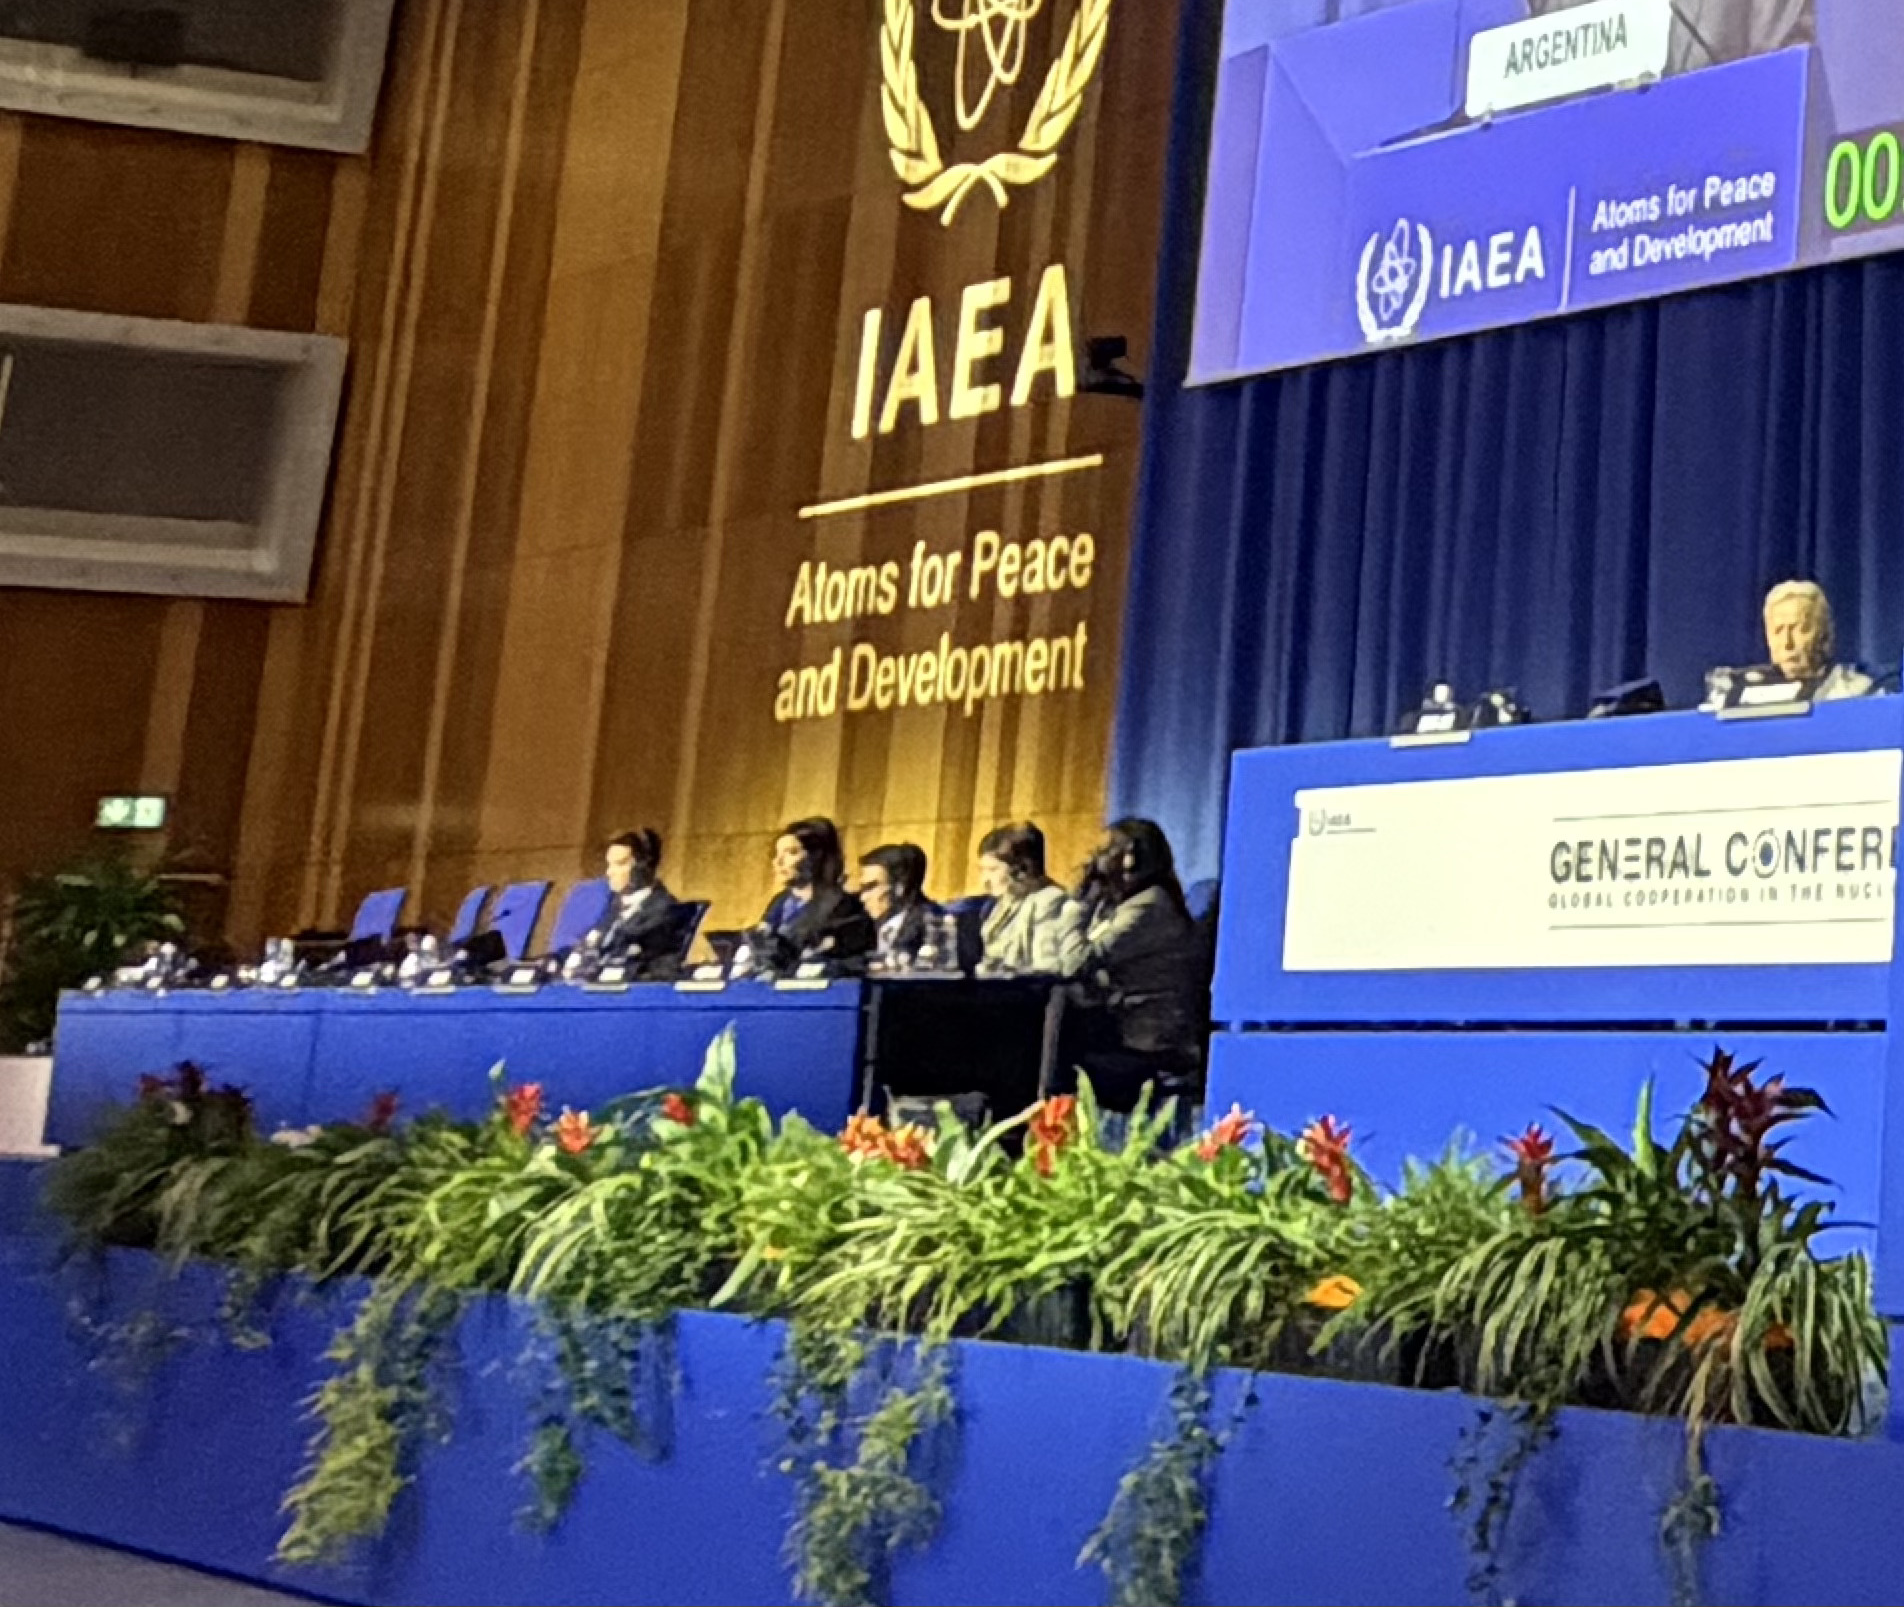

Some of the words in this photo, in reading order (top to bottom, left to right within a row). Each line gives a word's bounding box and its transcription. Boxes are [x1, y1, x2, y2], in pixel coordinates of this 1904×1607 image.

[1504, 13, 1628, 79] ARGENTINA
[1592, 197, 1661, 234] Atoms
[1667, 182, 1696, 216] for
[1703, 170, 1777, 210] Peace
[1438, 225, 1546, 301] IAEA
[1588, 239, 1629, 276] and
[1633, 211, 1775, 268] Development
[851, 262, 1078, 440] IAEA
[784, 560, 898, 629] Atoms
[907, 539, 961, 609] for
[969, 530, 1095, 601] Peace
[774, 647, 841, 722] and
[847, 620, 1088, 718] Development
[1550, 832, 1712, 884] GENERAL
